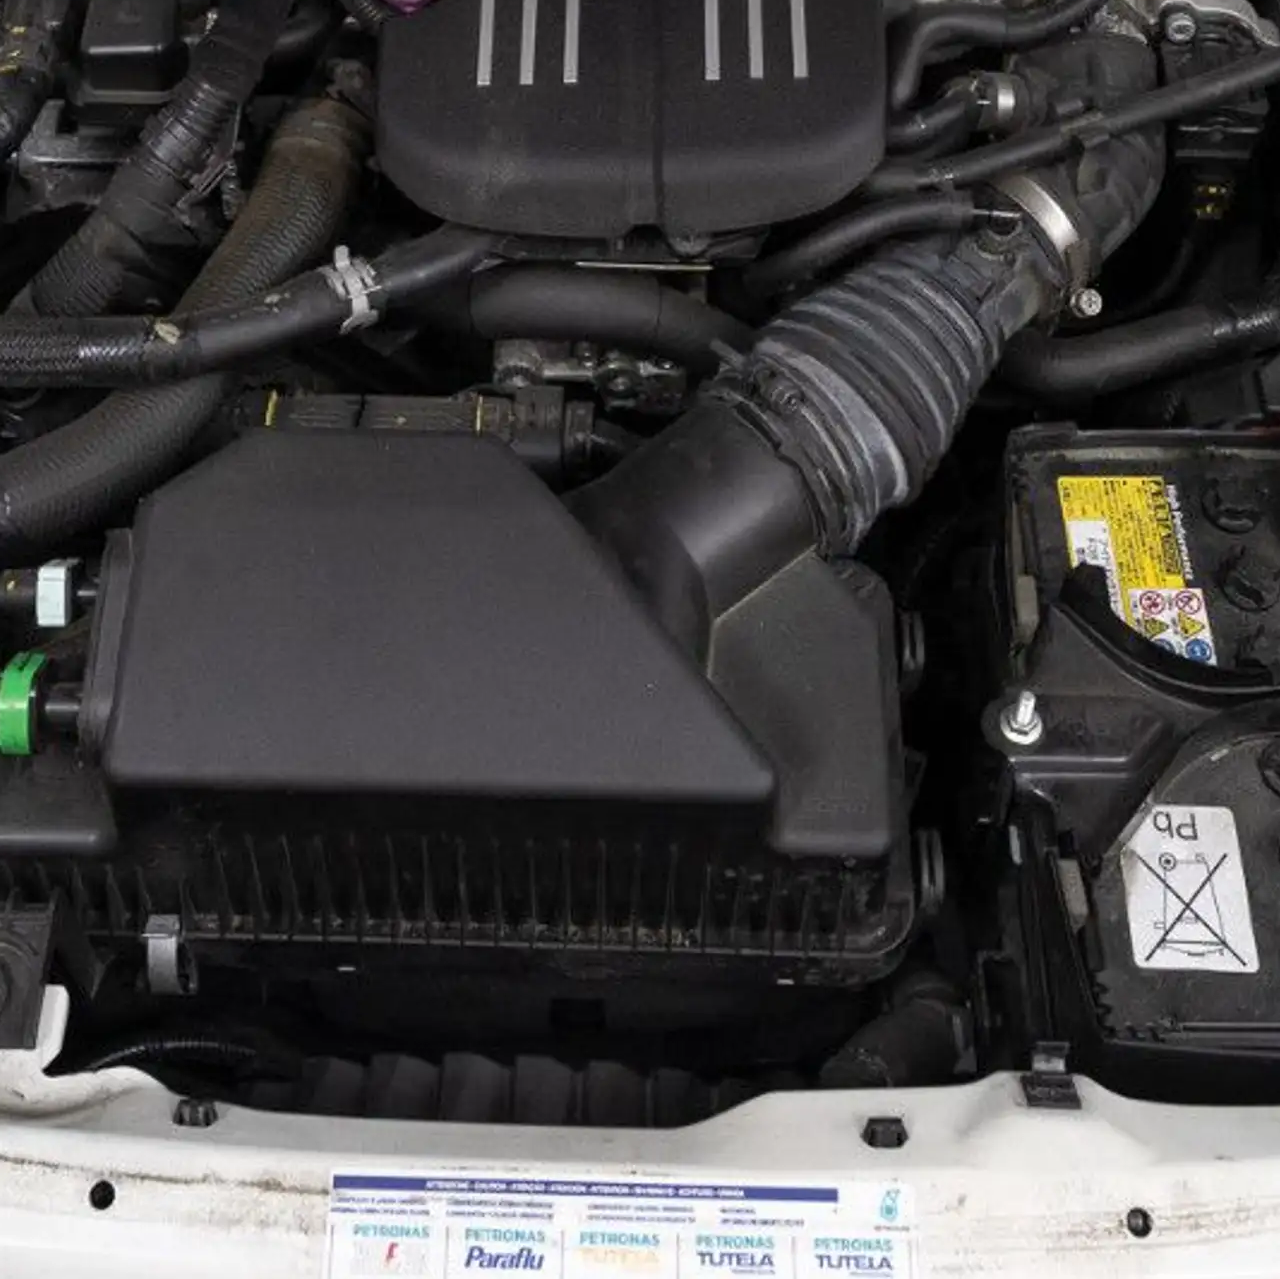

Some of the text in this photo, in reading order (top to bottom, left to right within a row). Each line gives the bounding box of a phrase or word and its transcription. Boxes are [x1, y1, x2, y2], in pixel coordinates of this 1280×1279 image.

[1165, 483, 1180, 511] High
[1153, 811, 1199, 841] Pb
[353, 1224, 430, 1238] PETRONAS
[465, 1228, 545, 1243] PETRONAS
[579, 1231, 661, 1247] PETRONAS
[696, 1235, 775, 1249] PETRONAS
[813, 1237, 894, 1252] PETRONAS
[463, 1245, 545, 1271] Paraflu
[696, 1252, 775, 1267] TUTELA
[814, 1254, 894, 1271] TUTELA
